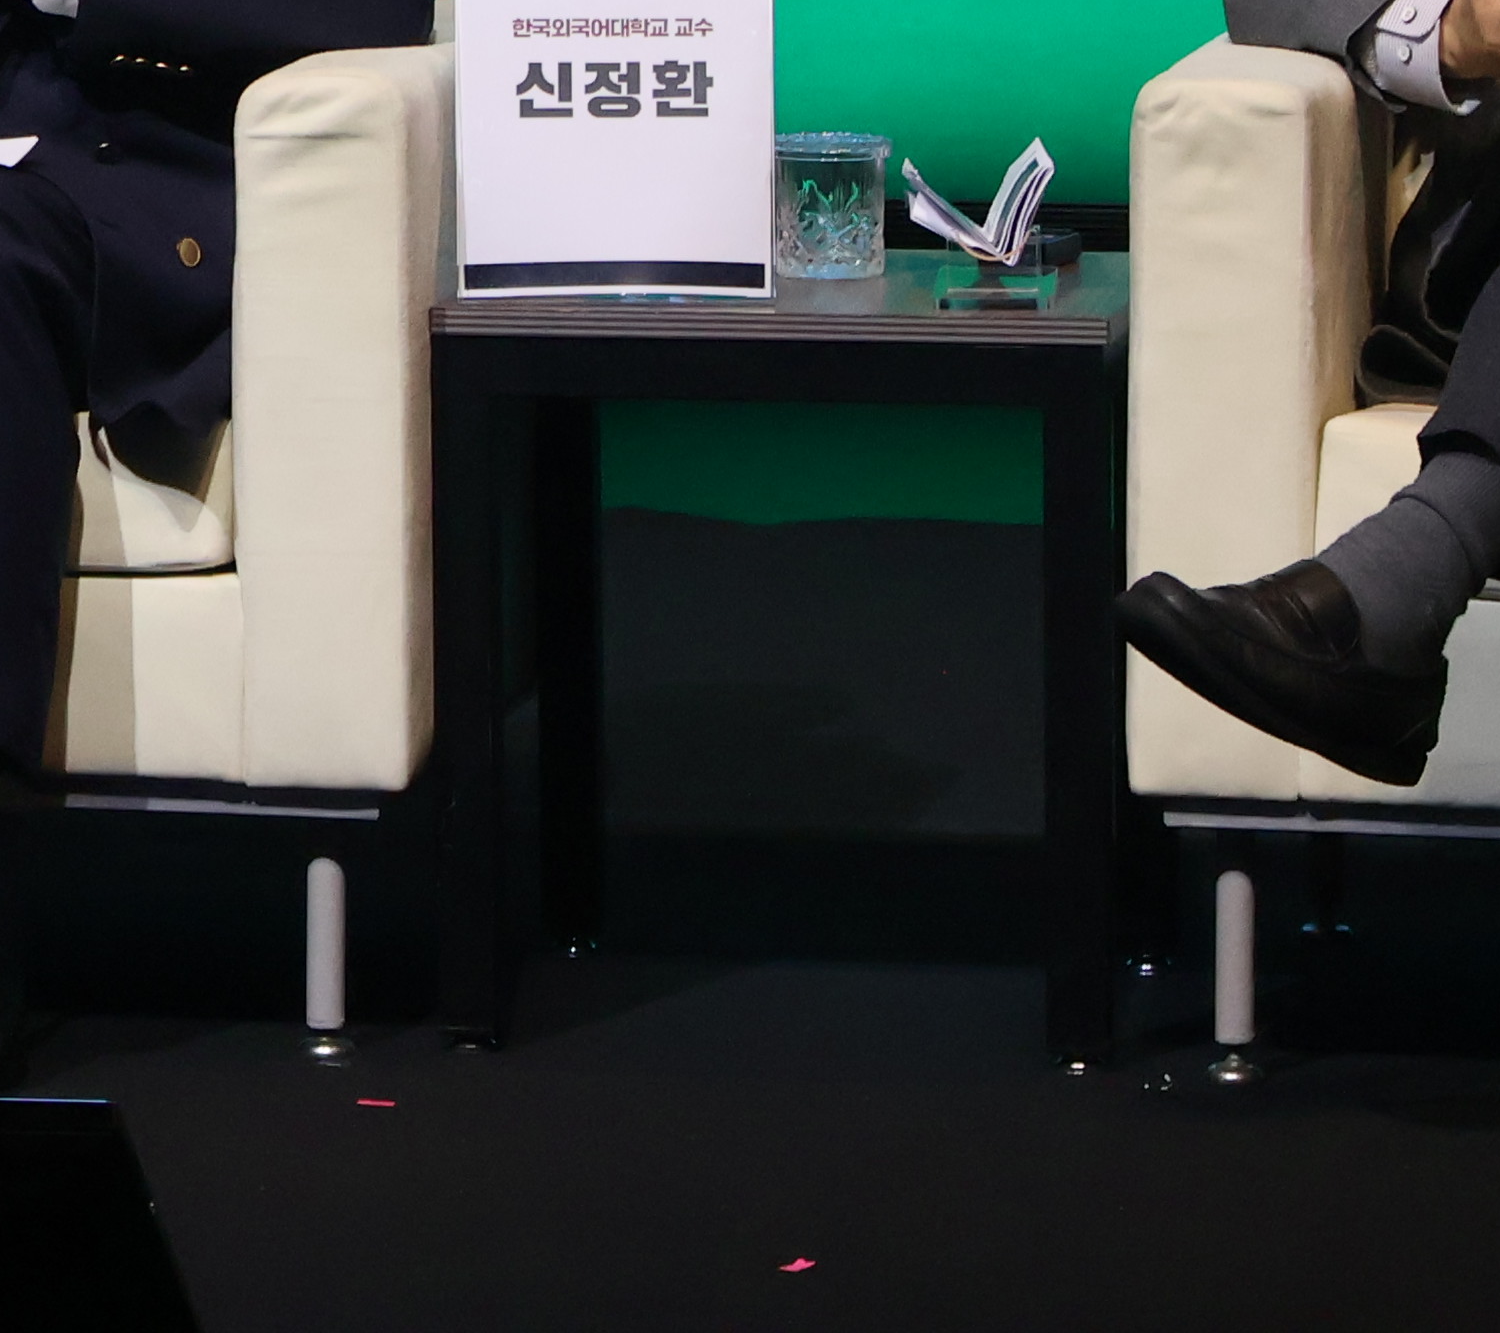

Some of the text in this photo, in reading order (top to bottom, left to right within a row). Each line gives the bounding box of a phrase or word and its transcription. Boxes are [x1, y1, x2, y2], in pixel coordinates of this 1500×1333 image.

[512, 17, 714, 38] 한국외국어대학교 교수
[516, 60, 714, 118] 신정환
